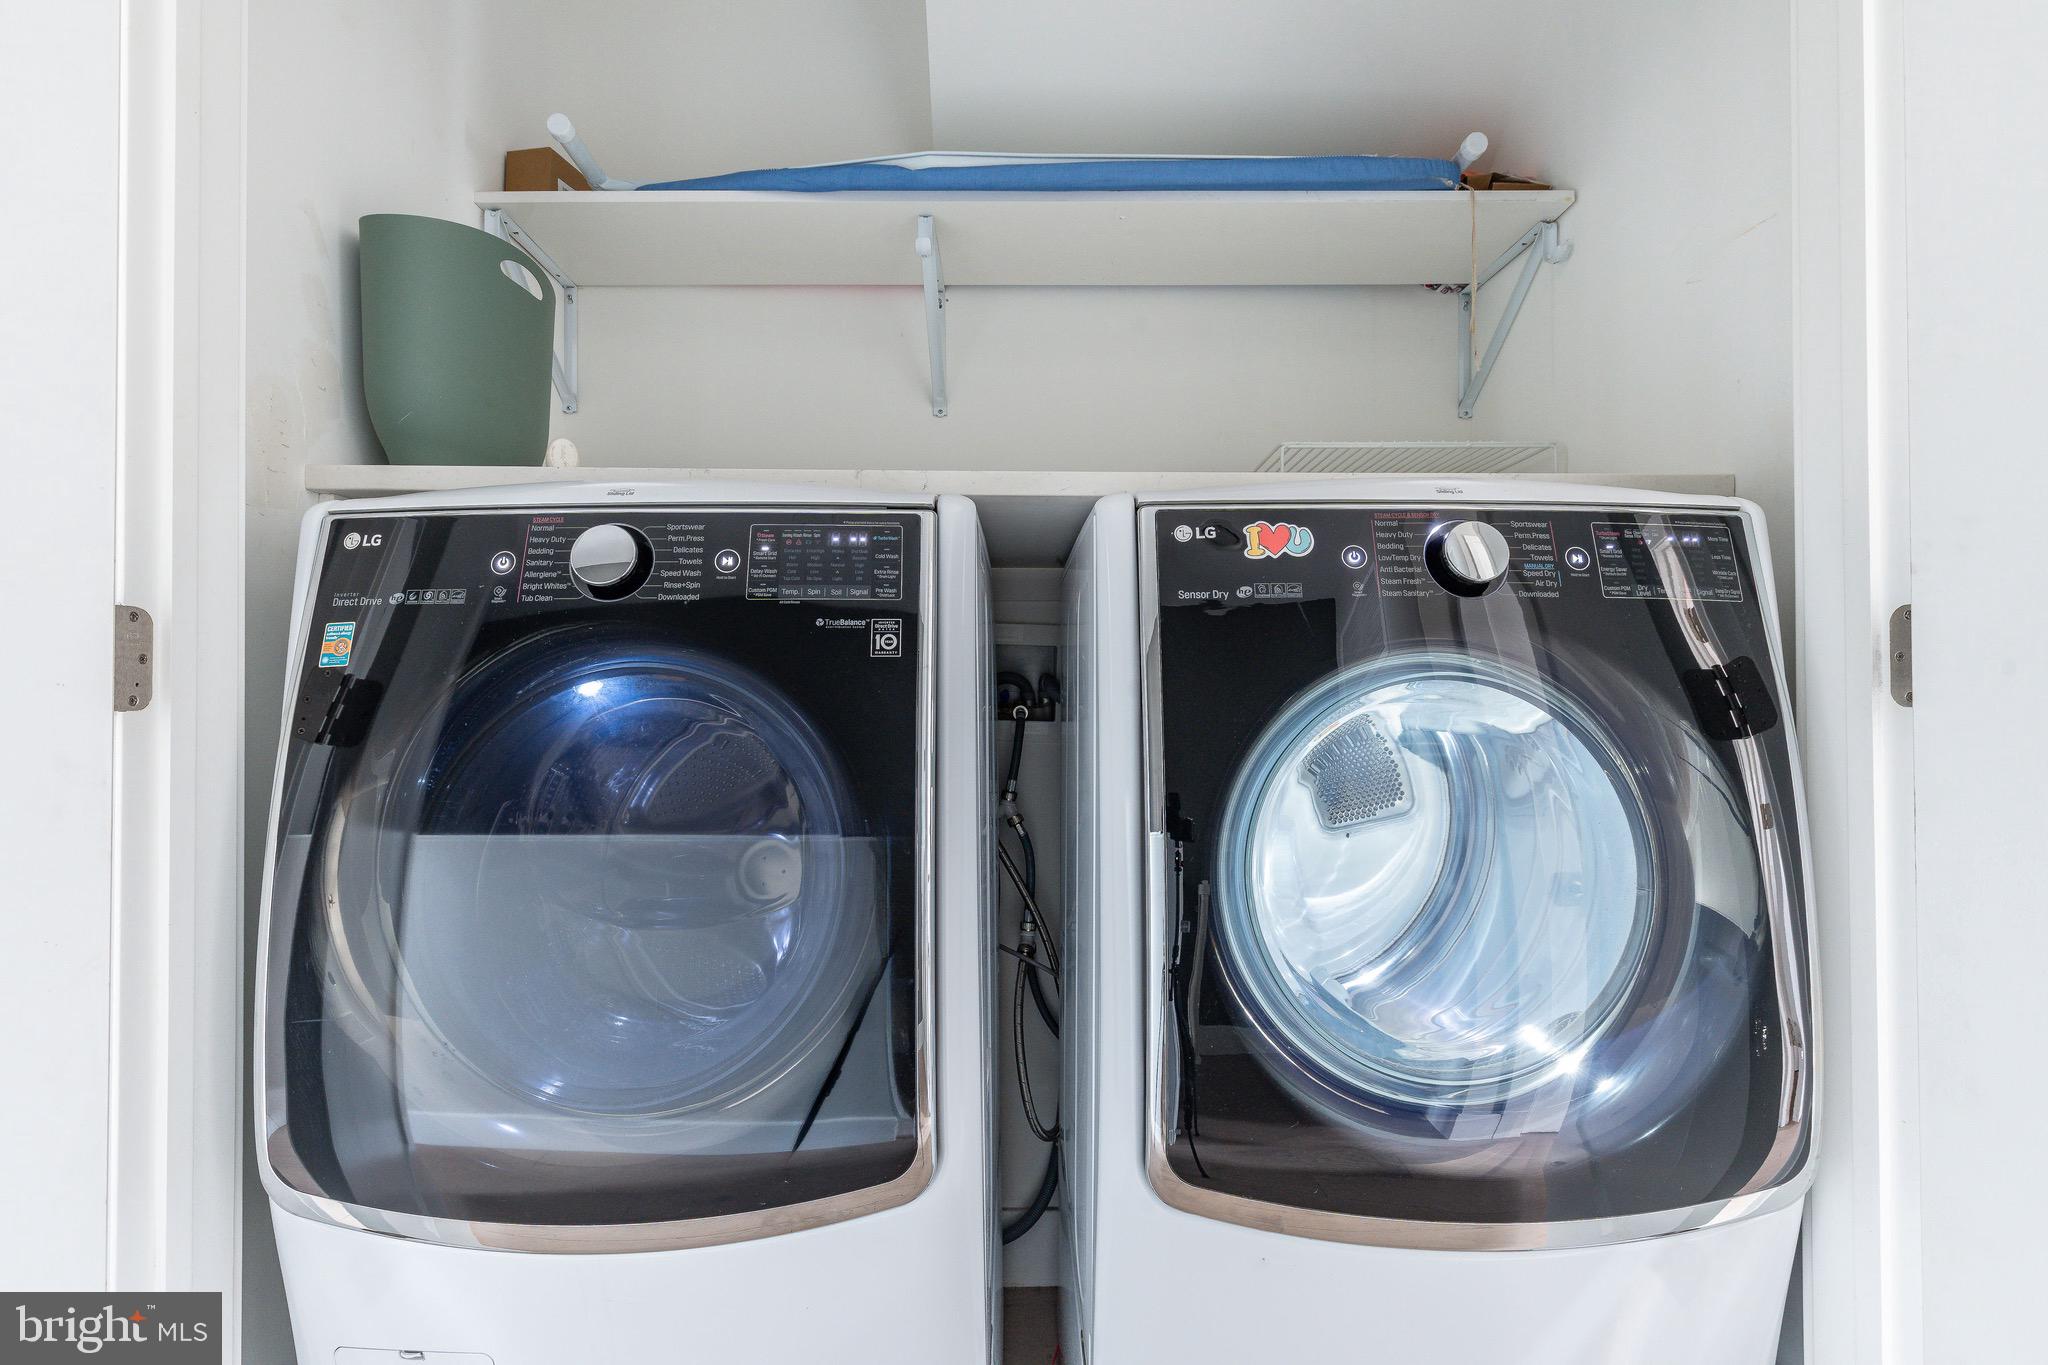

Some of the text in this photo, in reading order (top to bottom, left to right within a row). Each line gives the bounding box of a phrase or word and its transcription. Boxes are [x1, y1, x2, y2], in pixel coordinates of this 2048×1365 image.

[666, 523, 705, 531] Sportswear
[1195, 527, 1216, 539] LG
[1397, 531, 1414, 539] Duty
[362, 534, 382, 547] LG
[529, 536, 567, 544] Heavy Duty
[527, 547, 554, 555] Bedding
[1522, 543, 1552, 551] Delicates
[1410, 554, 1422, 562] Dry
[526, 559, 554, 567] Sanitary
[660, 569, 702, 578] Speed Wash
[1523, 570, 1556, 578] Speed Dry
[522, 583, 543, 591] Bright
[663, 581, 701, 589] Rinse+Spin
[1545, 580, 1558, 588] Dry
[849, 588, 869, 596] Signal
[1178, 590, 1229, 600] Sensor Dry
[521, 594, 553, 602] Tub Clean
[657, 593, 700, 601] Downloaded
[332, 596, 383, 607] Direct Drive
[875, 633, 898, 650] 10
